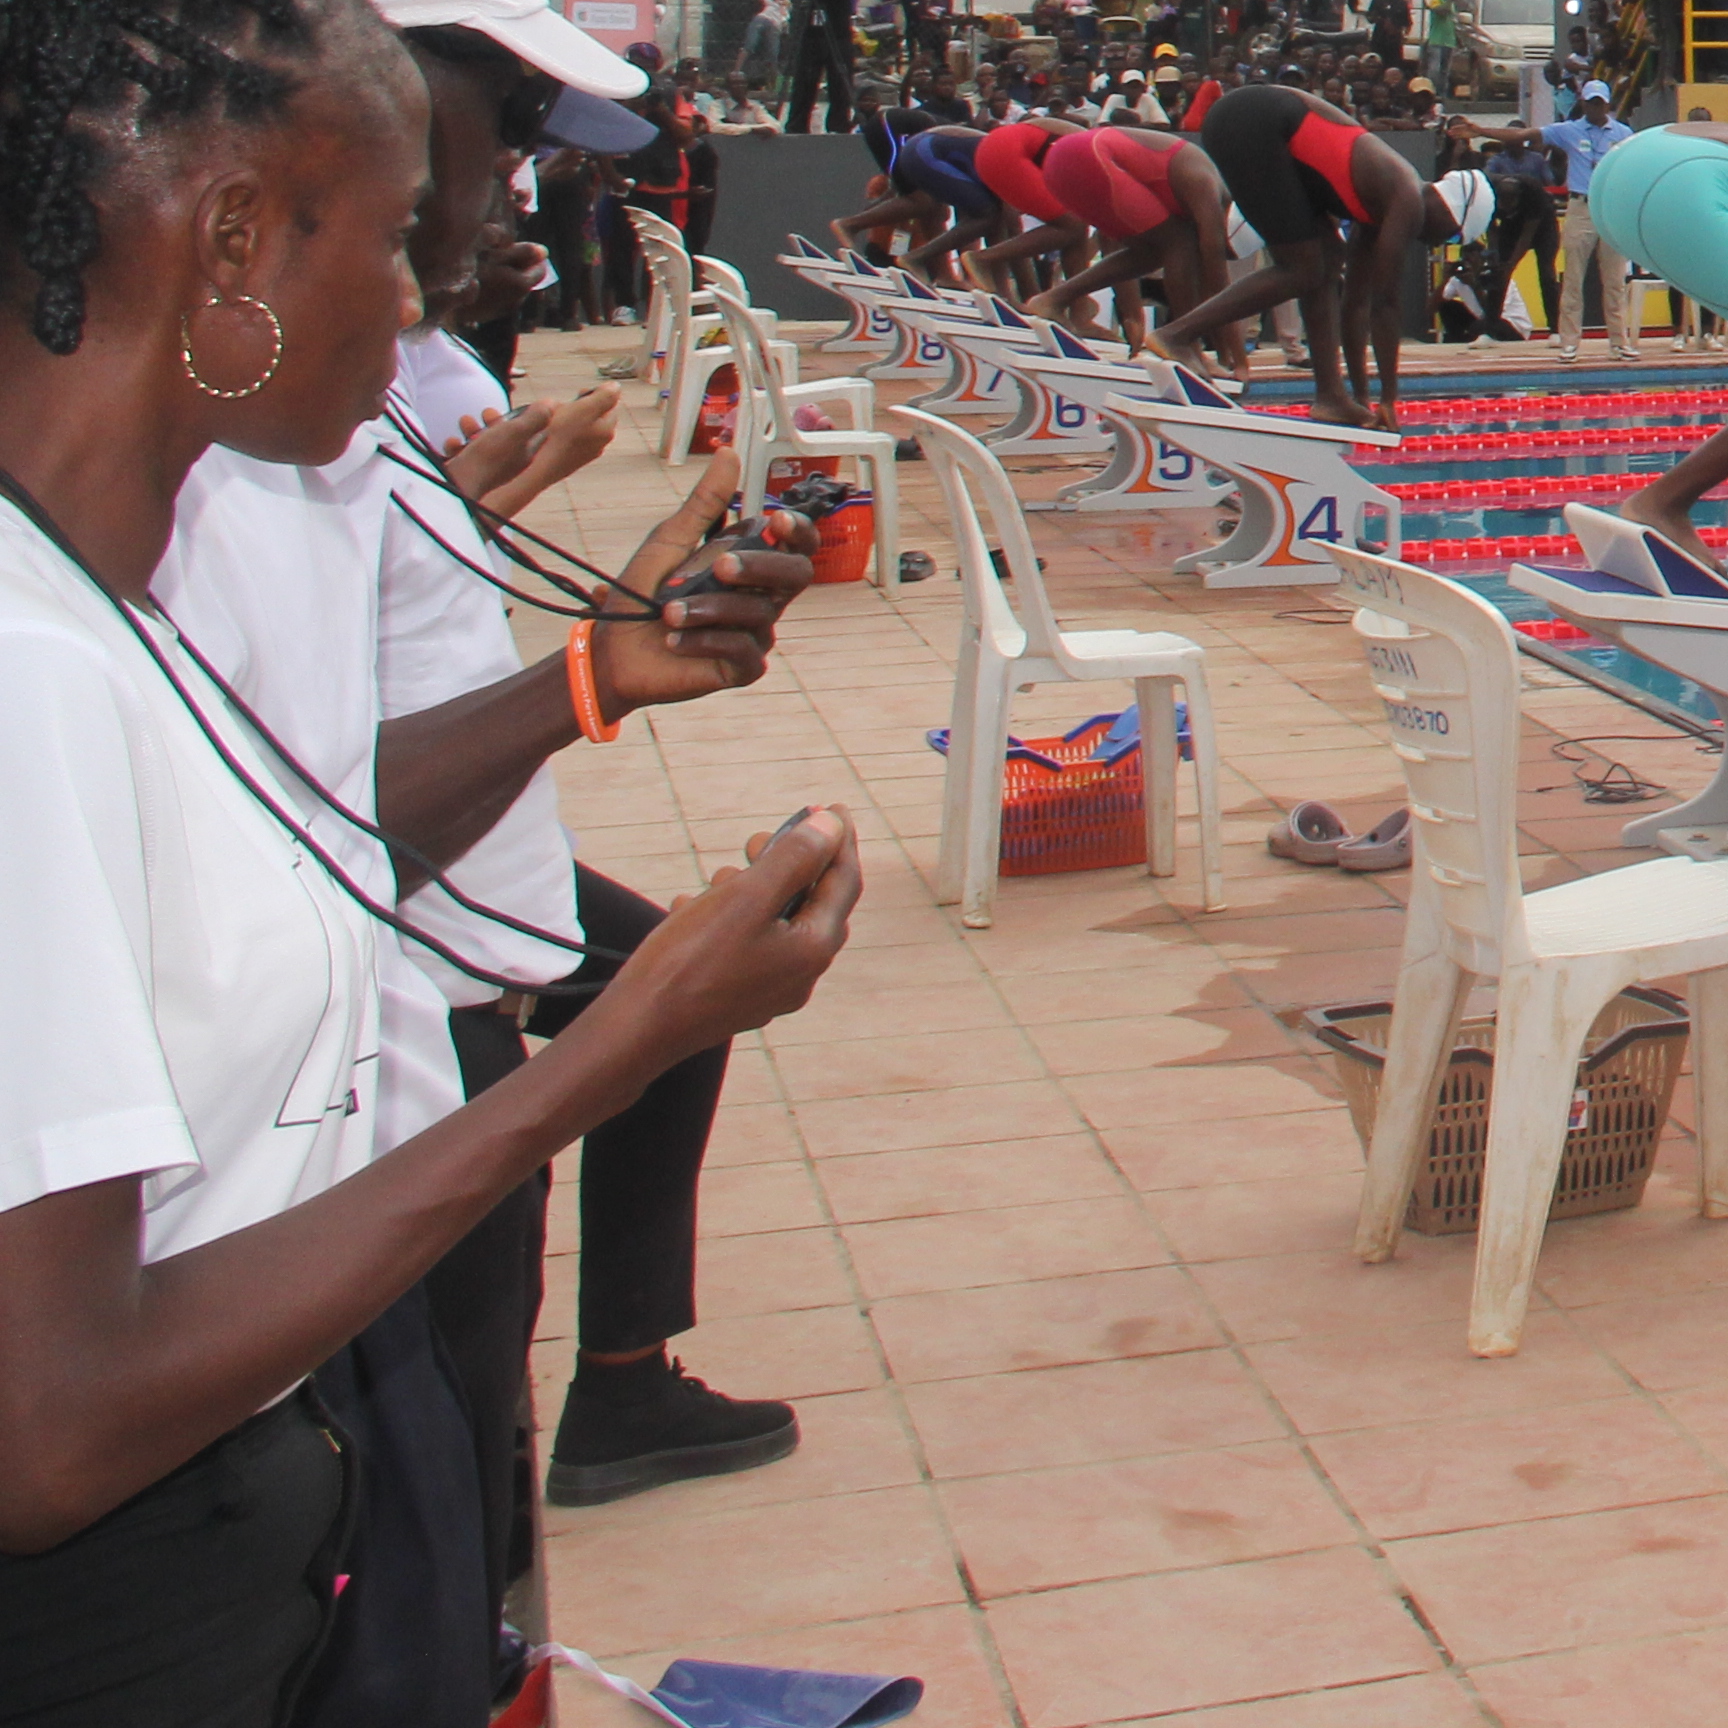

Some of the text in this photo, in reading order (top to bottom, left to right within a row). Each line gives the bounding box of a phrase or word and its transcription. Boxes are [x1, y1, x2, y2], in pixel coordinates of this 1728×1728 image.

[1056, 394, 1087, 428] 6
[1159, 441, 1194, 481] 5
[1298, 496, 1344, 543] 4
